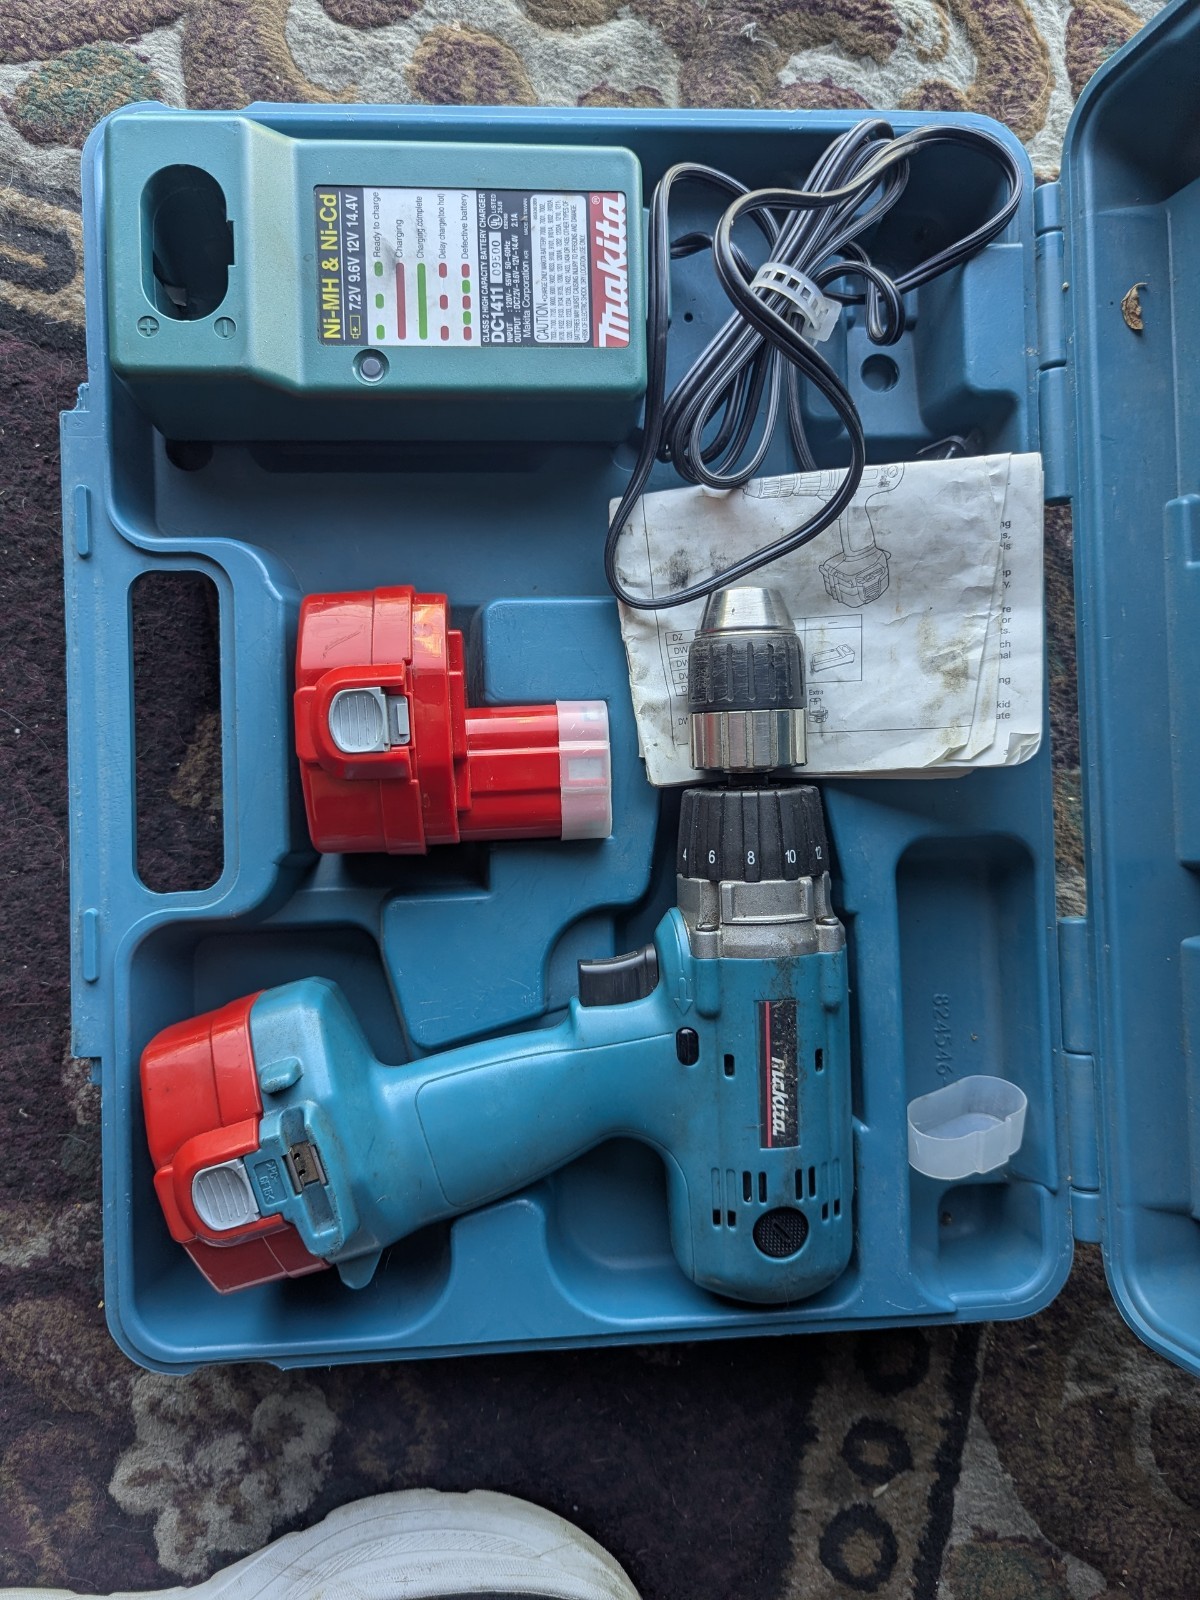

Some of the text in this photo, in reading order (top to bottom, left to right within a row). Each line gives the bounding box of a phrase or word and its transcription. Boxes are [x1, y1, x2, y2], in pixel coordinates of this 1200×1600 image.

[372, 192, 381, 219] charge
[437, 194, 445, 205] hot)
[460, 193, 468, 220] battery
[373, 232, 382, 257] Ready
[395, 220, 404, 258] Charging
[415, 196, 425, 258] Charging complete
[320, 194, 341, 338] Ni-MH & Ni-Cd
[346, 194, 361, 310] 7.2V 9.6V 12V 14.4V
[438, 242, 447, 259] Delay
[490, 240, 504, 342] DC1411 09500
[522, 251, 531, 337] Makita Corporation KR
[536, 303, 549, 340] CAUTION
[682, 846, 822, 865] 4 6 8 10 12
